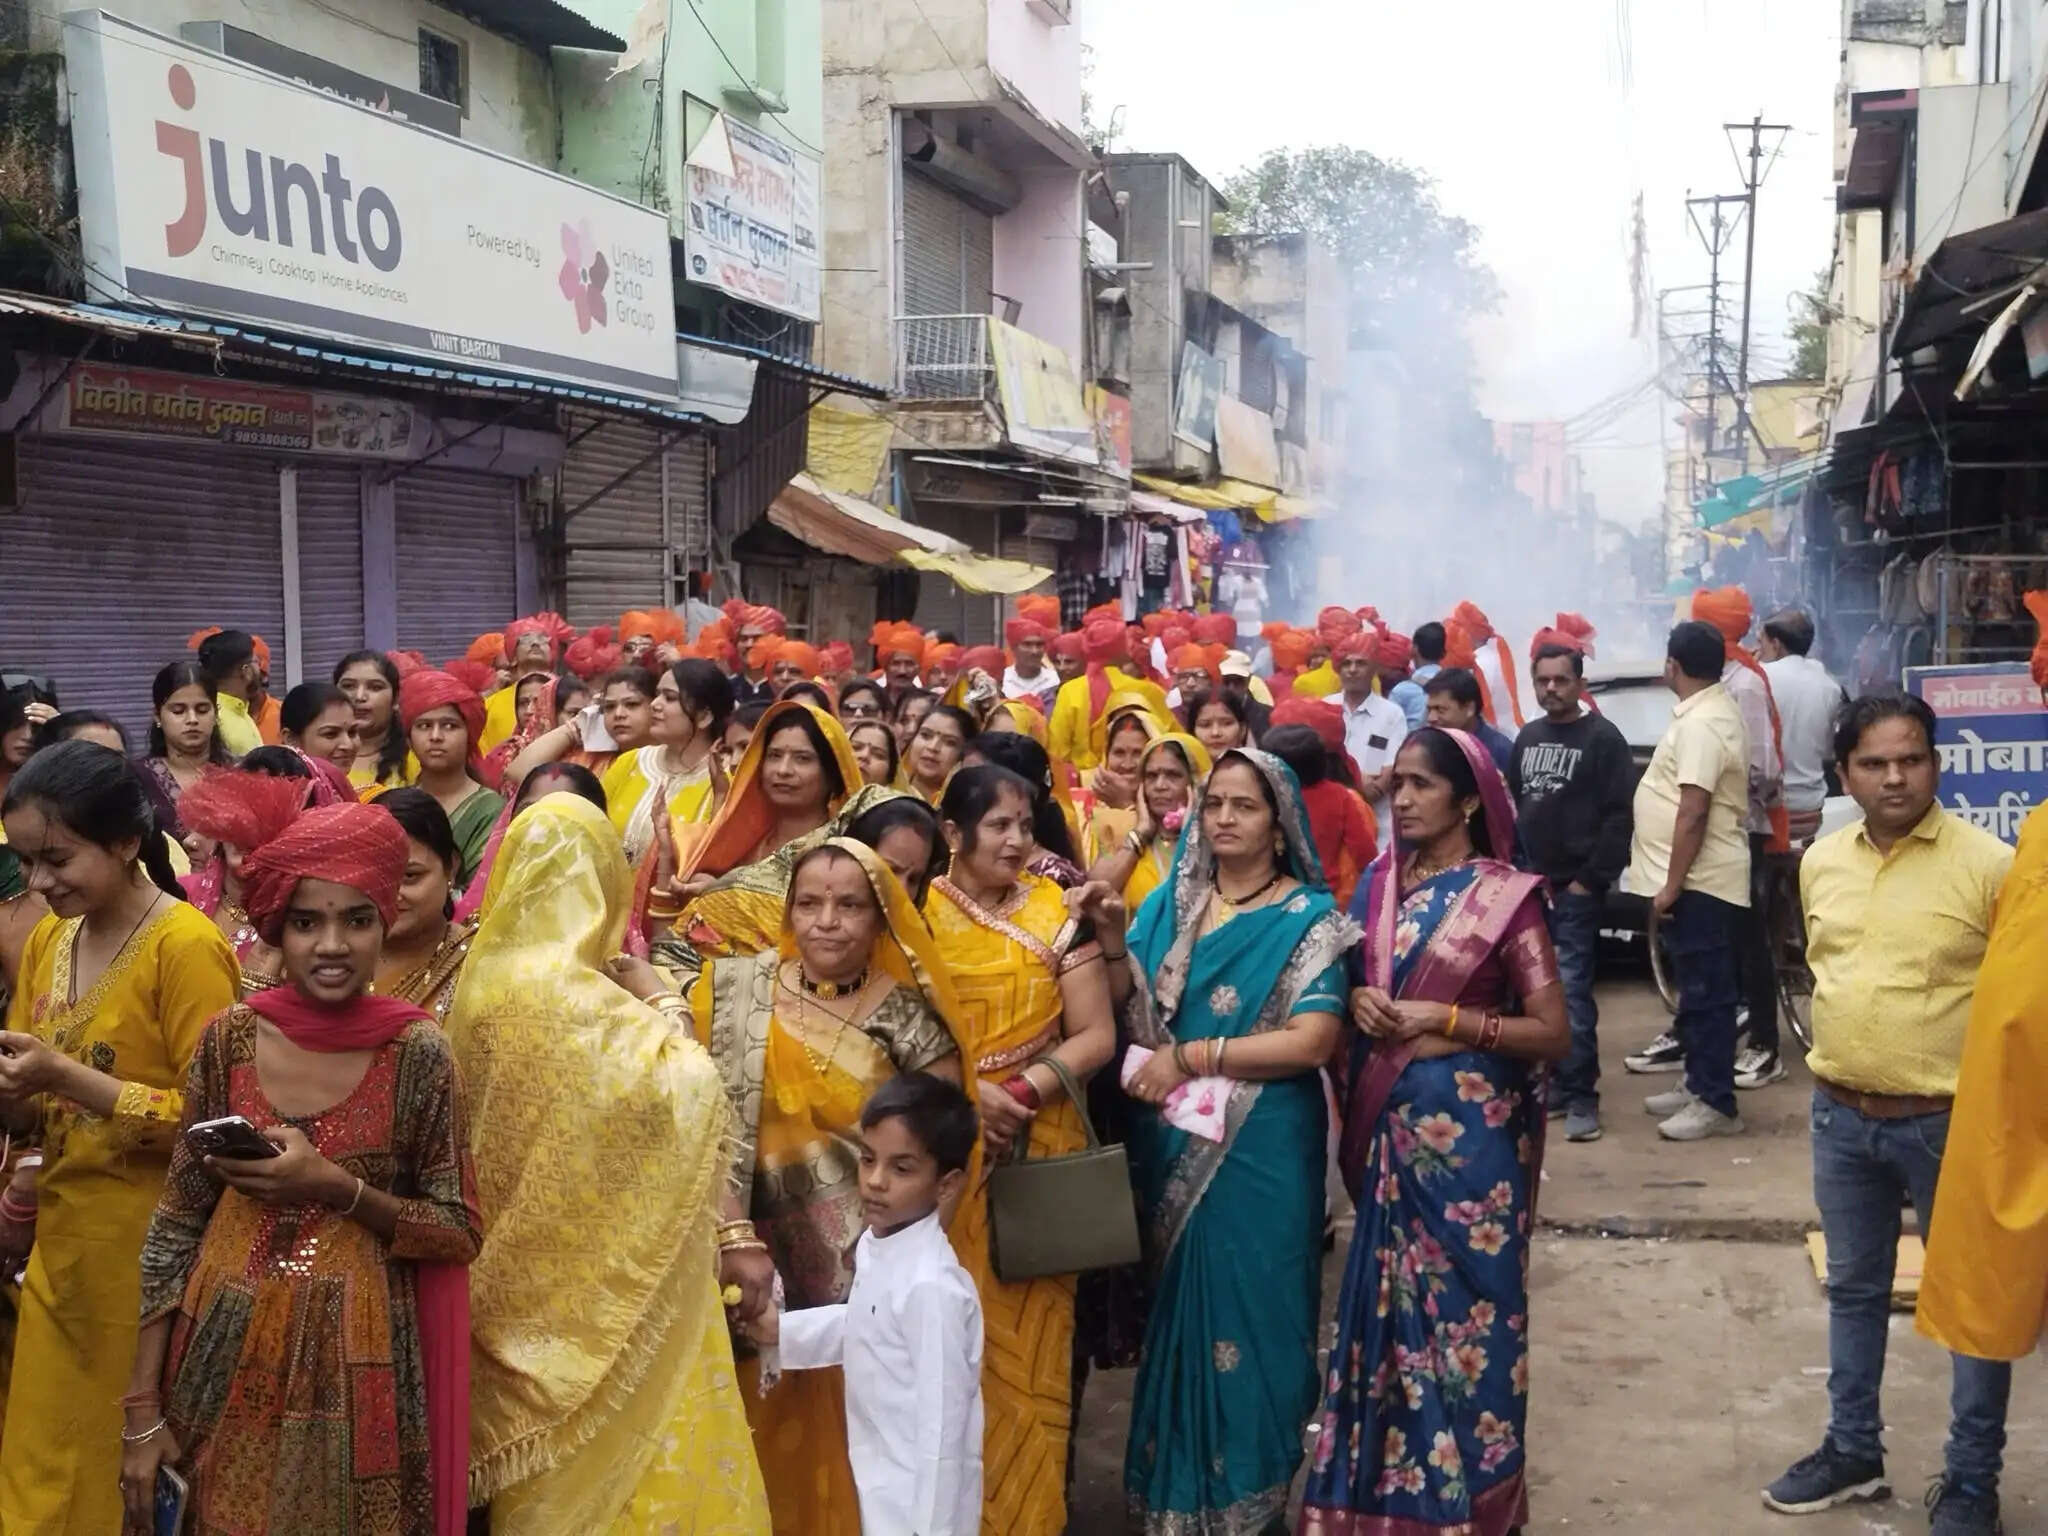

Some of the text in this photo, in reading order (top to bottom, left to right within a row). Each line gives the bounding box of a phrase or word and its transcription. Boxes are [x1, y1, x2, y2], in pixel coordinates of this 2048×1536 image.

[154, 63, 402, 273] junto
[467, 224, 541, 268] Powered by
[611, 243, 654, 278] United
[211, 244, 409, 304] Chimney Cooktop Home Appliances
[613, 271, 643, 301] Ekta
[616, 300, 656, 331] Group
[430, 332, 501, 361] VINIT BARTAN
[206, 399, 267, 434] दुकान
[1934, 728, 2048, 775] मोबा
